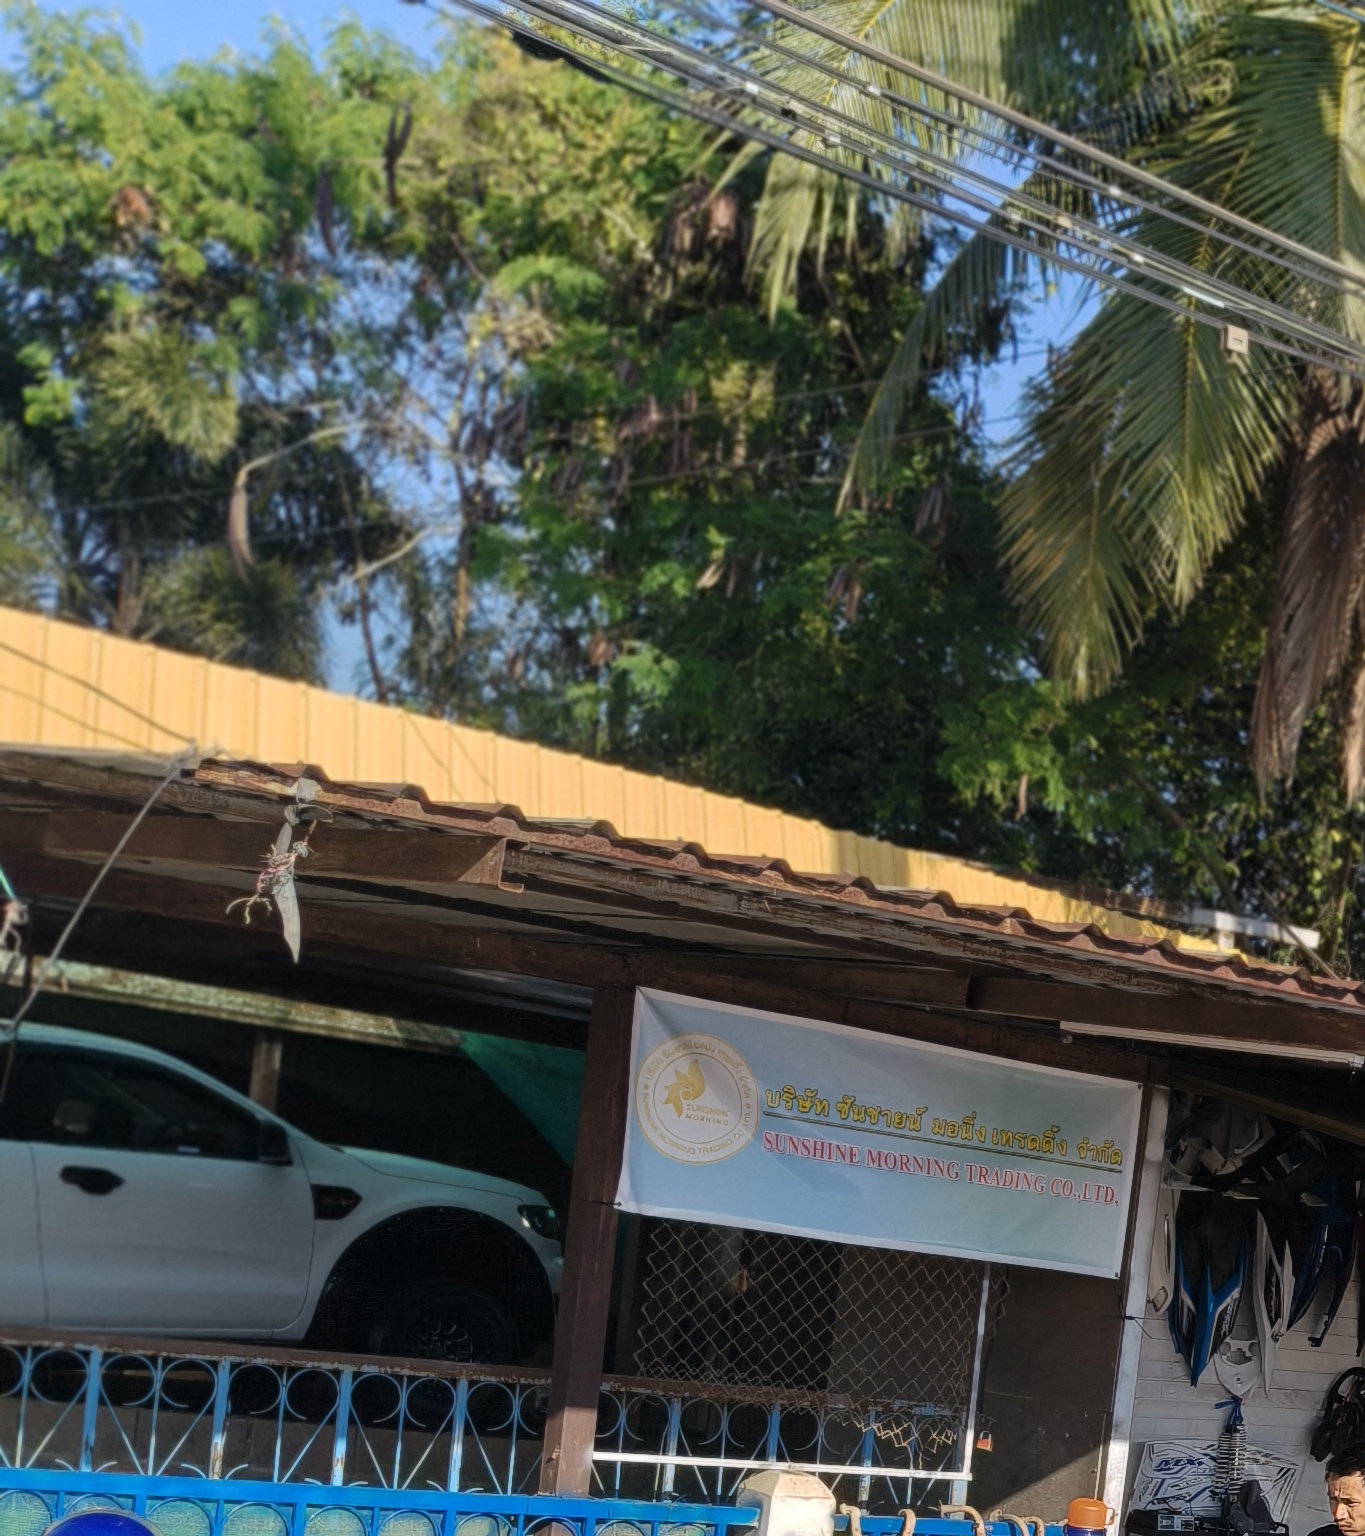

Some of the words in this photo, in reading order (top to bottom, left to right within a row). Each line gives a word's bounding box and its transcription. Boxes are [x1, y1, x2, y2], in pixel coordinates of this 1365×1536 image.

[765, 1085, 829, 1117] บริษัท
[836, 1095, 928, 1132] ซันชายน์
[1077, 1137, 1122, 1166] จำกัด
[763, 1131, 860, 1165] SUNSHINE
[866, 1148, 960, 1180] MORNING
[965, 1163, 1046, 1194] TRADING
